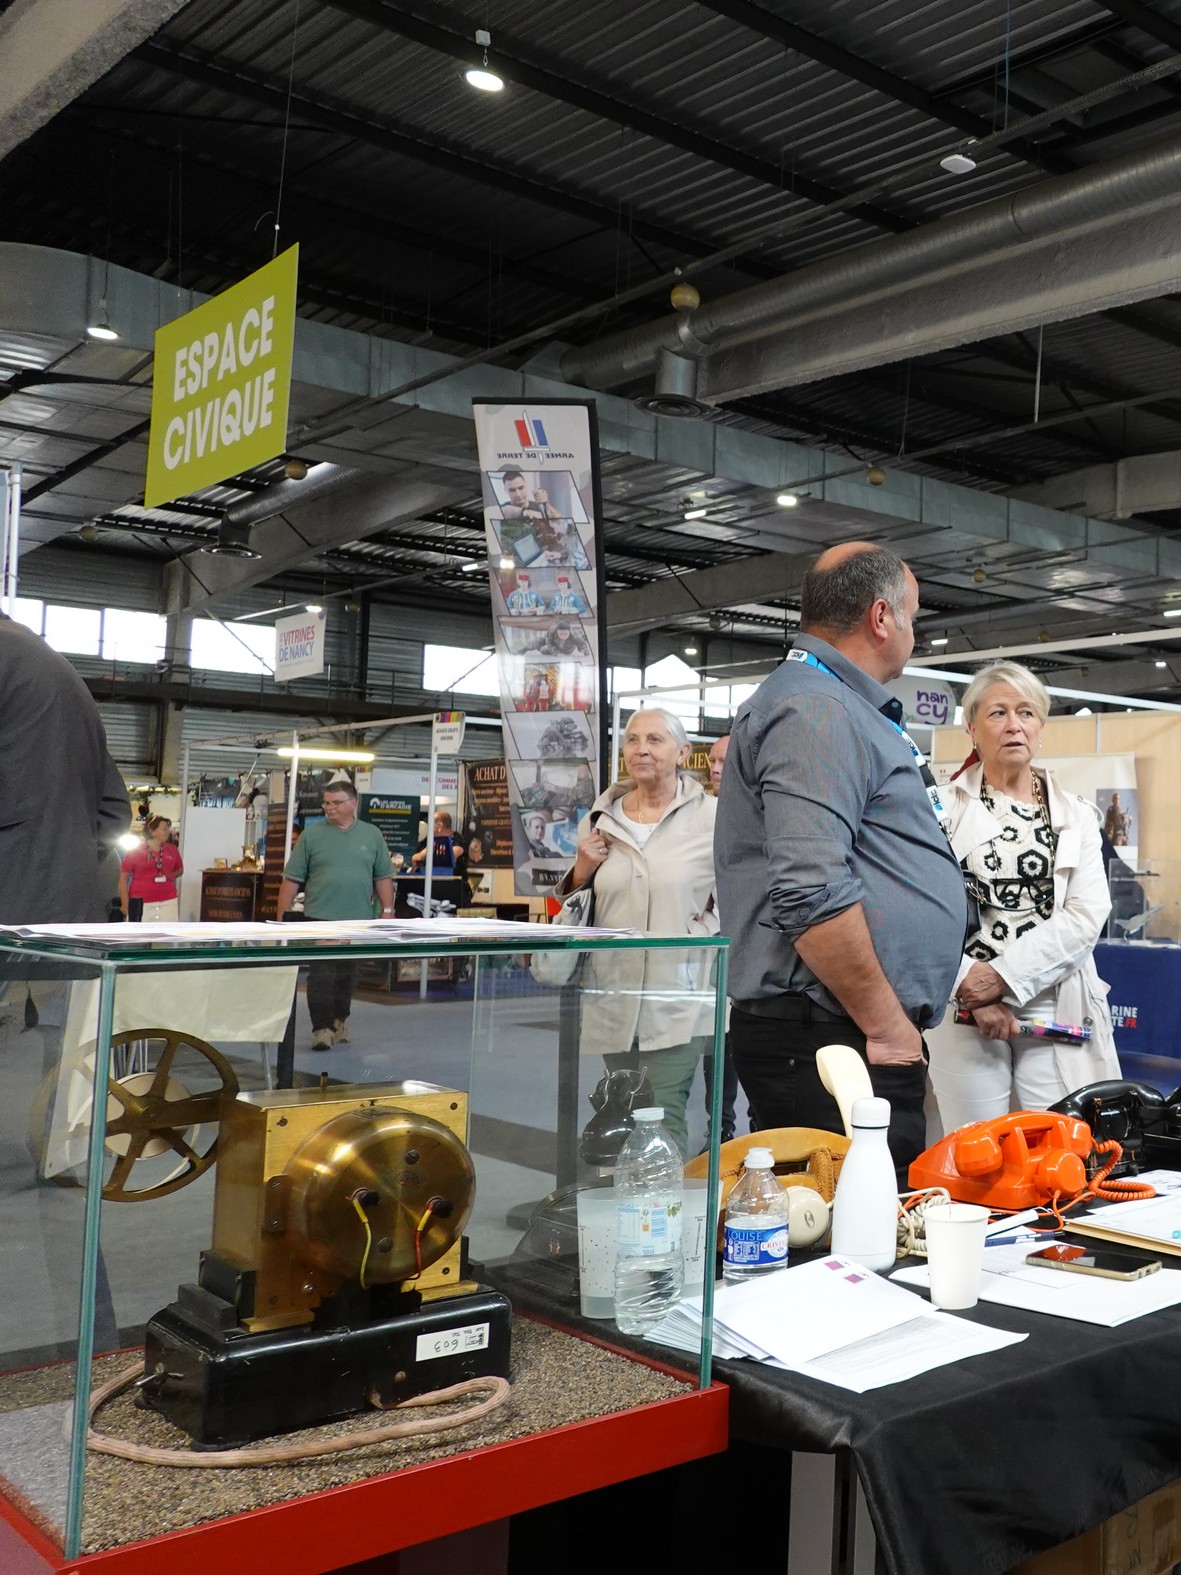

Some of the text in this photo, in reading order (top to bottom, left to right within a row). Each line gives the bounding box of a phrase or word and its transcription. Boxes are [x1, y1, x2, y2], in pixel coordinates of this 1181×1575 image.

[173, 295, 275, 403] ESPACE
[163, 367, 276, 471] CIVIQUE
[283, 624, 316, 647] VITRINES
[278, 640, 315, 662] DE NANCY
[474, 765, 500, 782] ACHAT
[433, 1338, 459, 1353] 603
